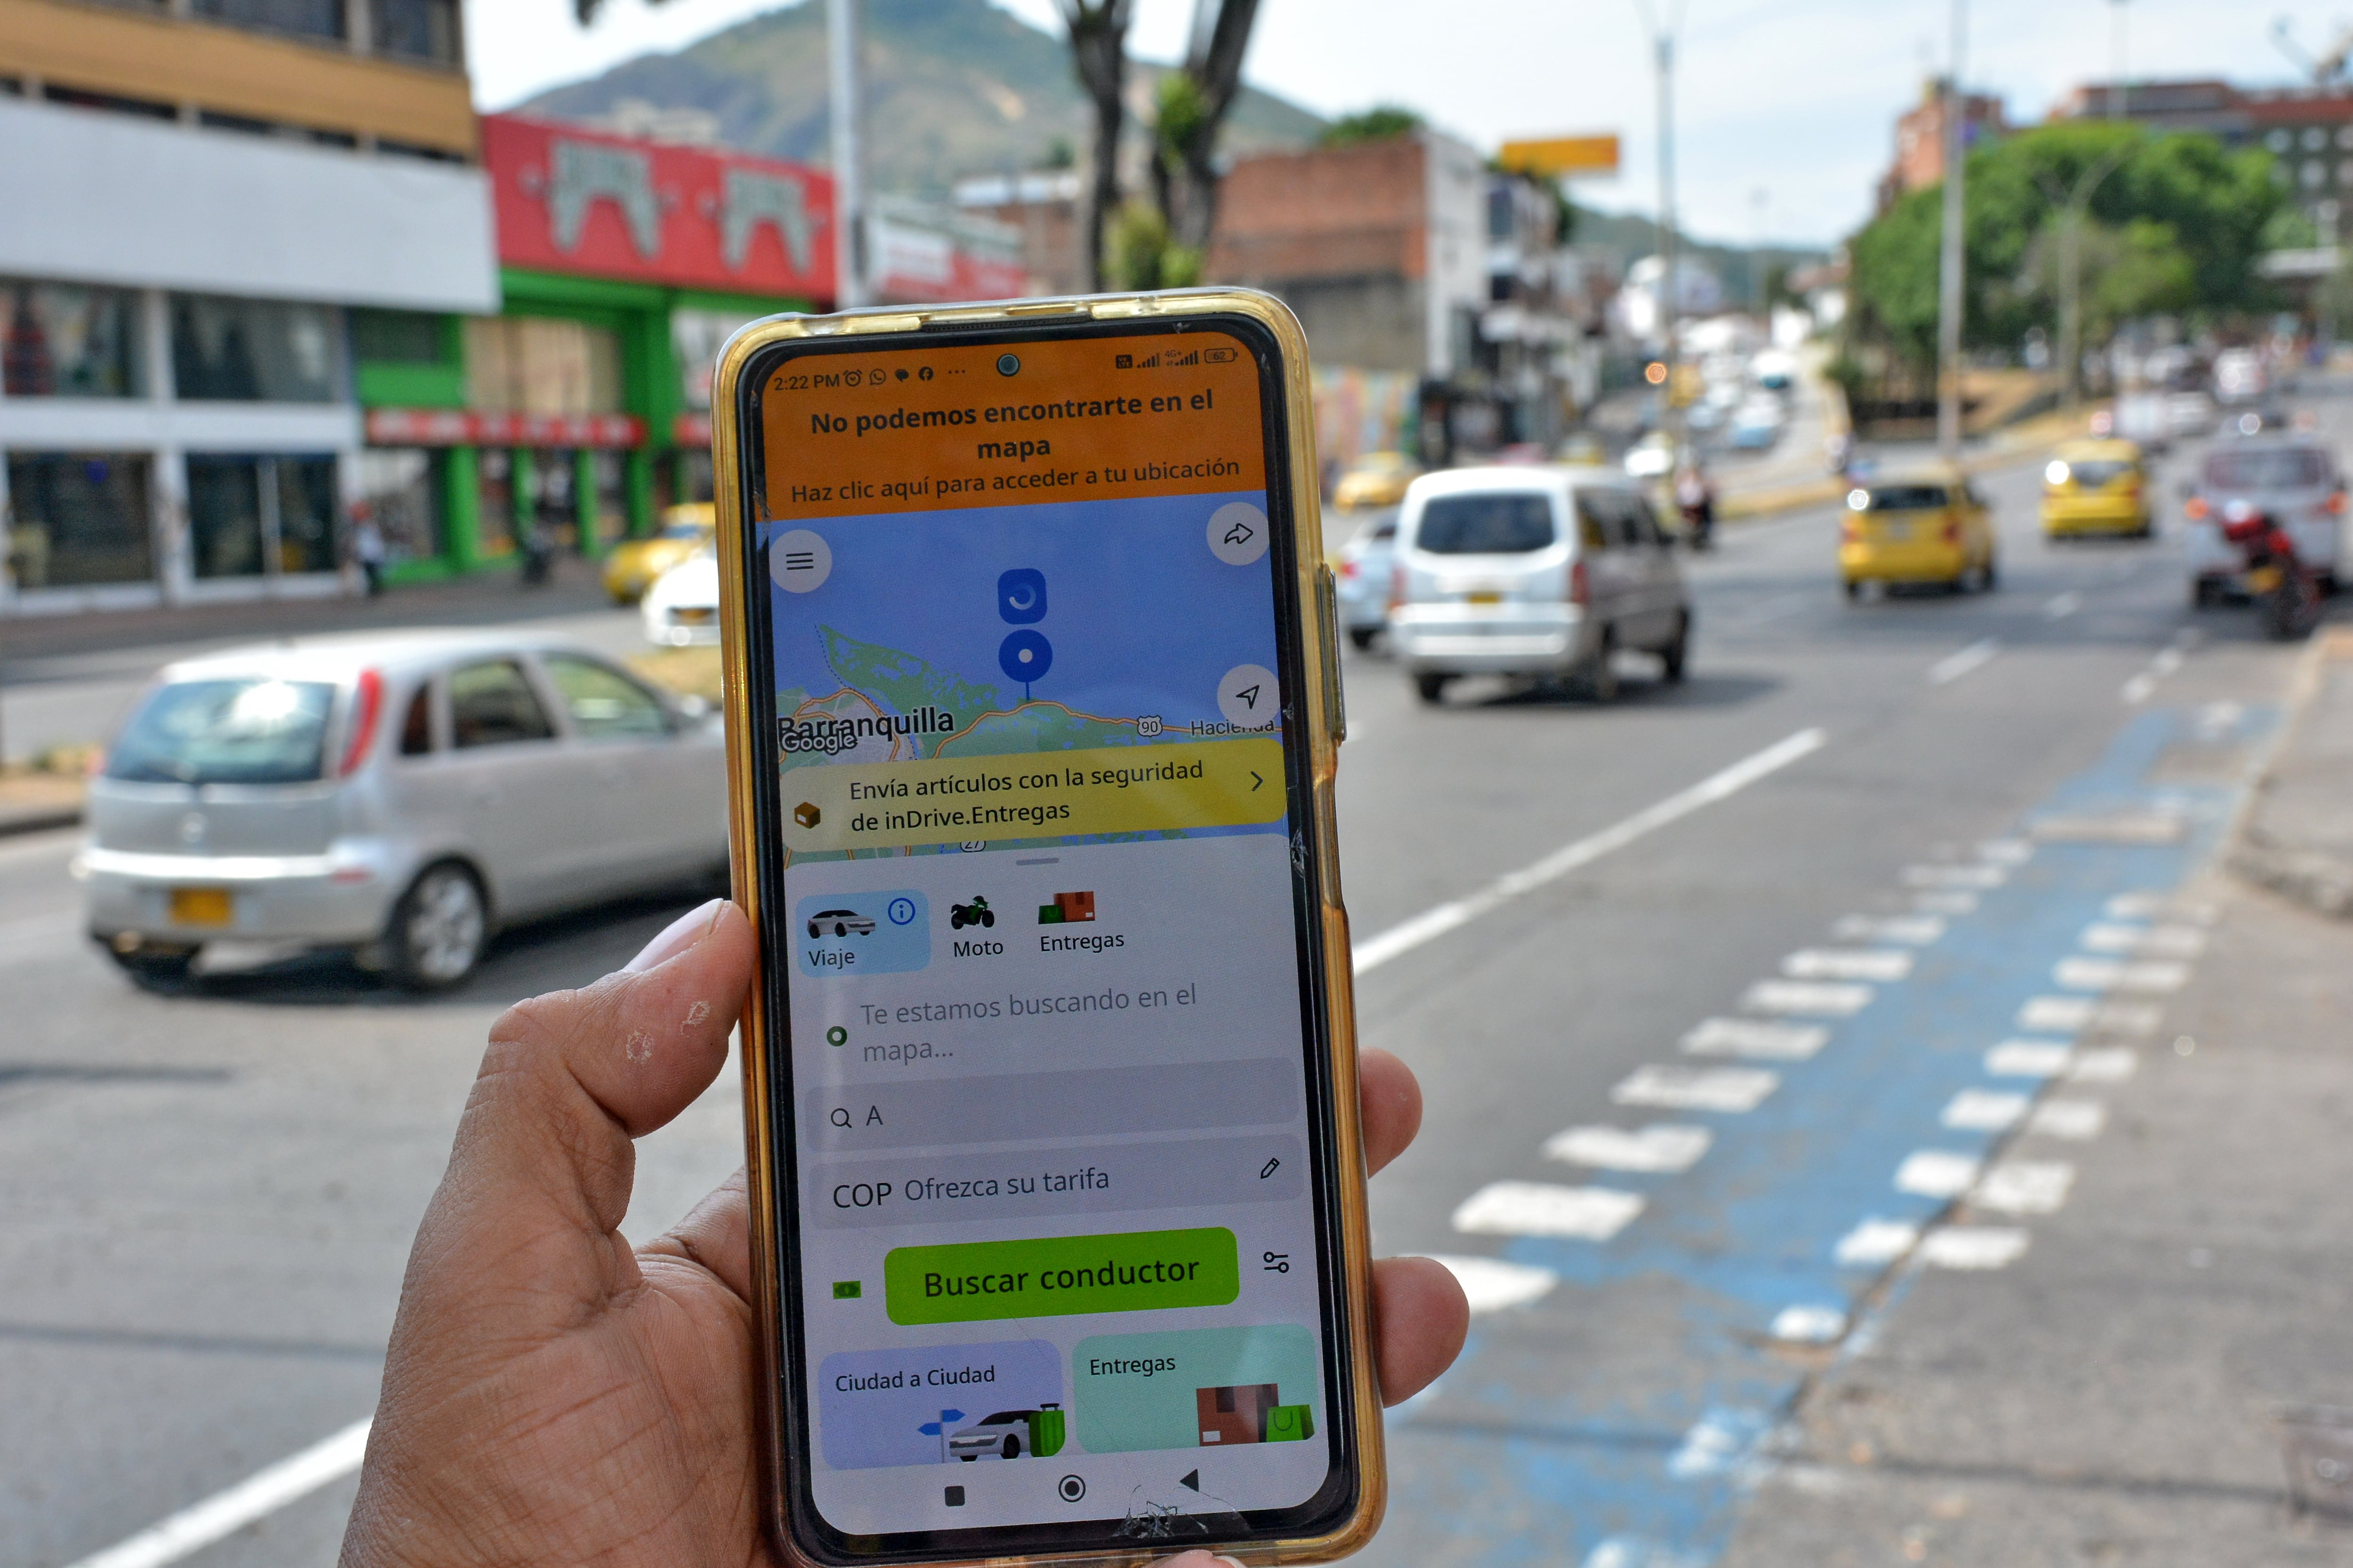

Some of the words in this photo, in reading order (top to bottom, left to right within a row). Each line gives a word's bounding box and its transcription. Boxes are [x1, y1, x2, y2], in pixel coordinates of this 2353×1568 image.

[1213, 352, 1226, 360] 62
[774, 375, 809, 391] 2:22
[813, 373, 840, 388] PM
[811, 413, 848, 434] No
[856, 408, 976, 438] podemos
[984, 396, 1142, 423] encontrarte
[1150, 396, 1182, 413] en
[1190, 388, 1213, 410] el
[977, 440, 1050, 463] mapa
[792, 485, 833, 503] Haz
[839, 480, 874, 500] clic
[880, 476, 929, 501] aquí
[936, 478, 985, 499] para
[992, 468, 1079, 490] acceder
[1085, 471, 1097, 484] a
[1104, 467, 1127, 483] tu
[1134, 457, 1239, 481] ubicación
[778, 707, 954, 742] Barranquilla
[1142, 721, 1158, 733] 90
[782, 730, 857, 754] Google
[850, 778, 908, 800] Envía
[916, 773, 1012, 796] artículos
[1019, 774, 1058, 789] con
[1065, 768, 1084, 786] la
[1091, 760, 1203, 788] seguridad
[851, 813, 878, 832] de
[885, 805, 1070, 830] inDrive.Entregas
[953, 941, 1003, 957] Moto
[1040, 935, 1124, 953] Entregas
[808, 948, 855, 970] Viaje
[860, 1004, 888, 1025] Te
[896, 1001, 1001, 1023] estamos
[1009, 988, 1129, 1016] buscando
[1138, 991, 1168, 1008] en
[1176, 983, 1196, 1005] el
[864, 1042, 953, 1066] mapa...
[866, 1105, 883, 1126] A
[833, 1182, 892, 1208] COP
[905, 1177, 998, 1201] Ofrezca
[1007, 1177, 1035, 1195] su
[1042, 1167, 1109, 1192] tarifa
[925, 1272, 1029, 1297] Buscar
[1040, 1260, 1200, 1290] conductor
[835, 1370, 903, 1392] Ciudad
[910, 1374, 920, 1387] a
[927, 1365, 995, 1386] Ciudad
[1090, 1358, 1176, 1377] Entregas
